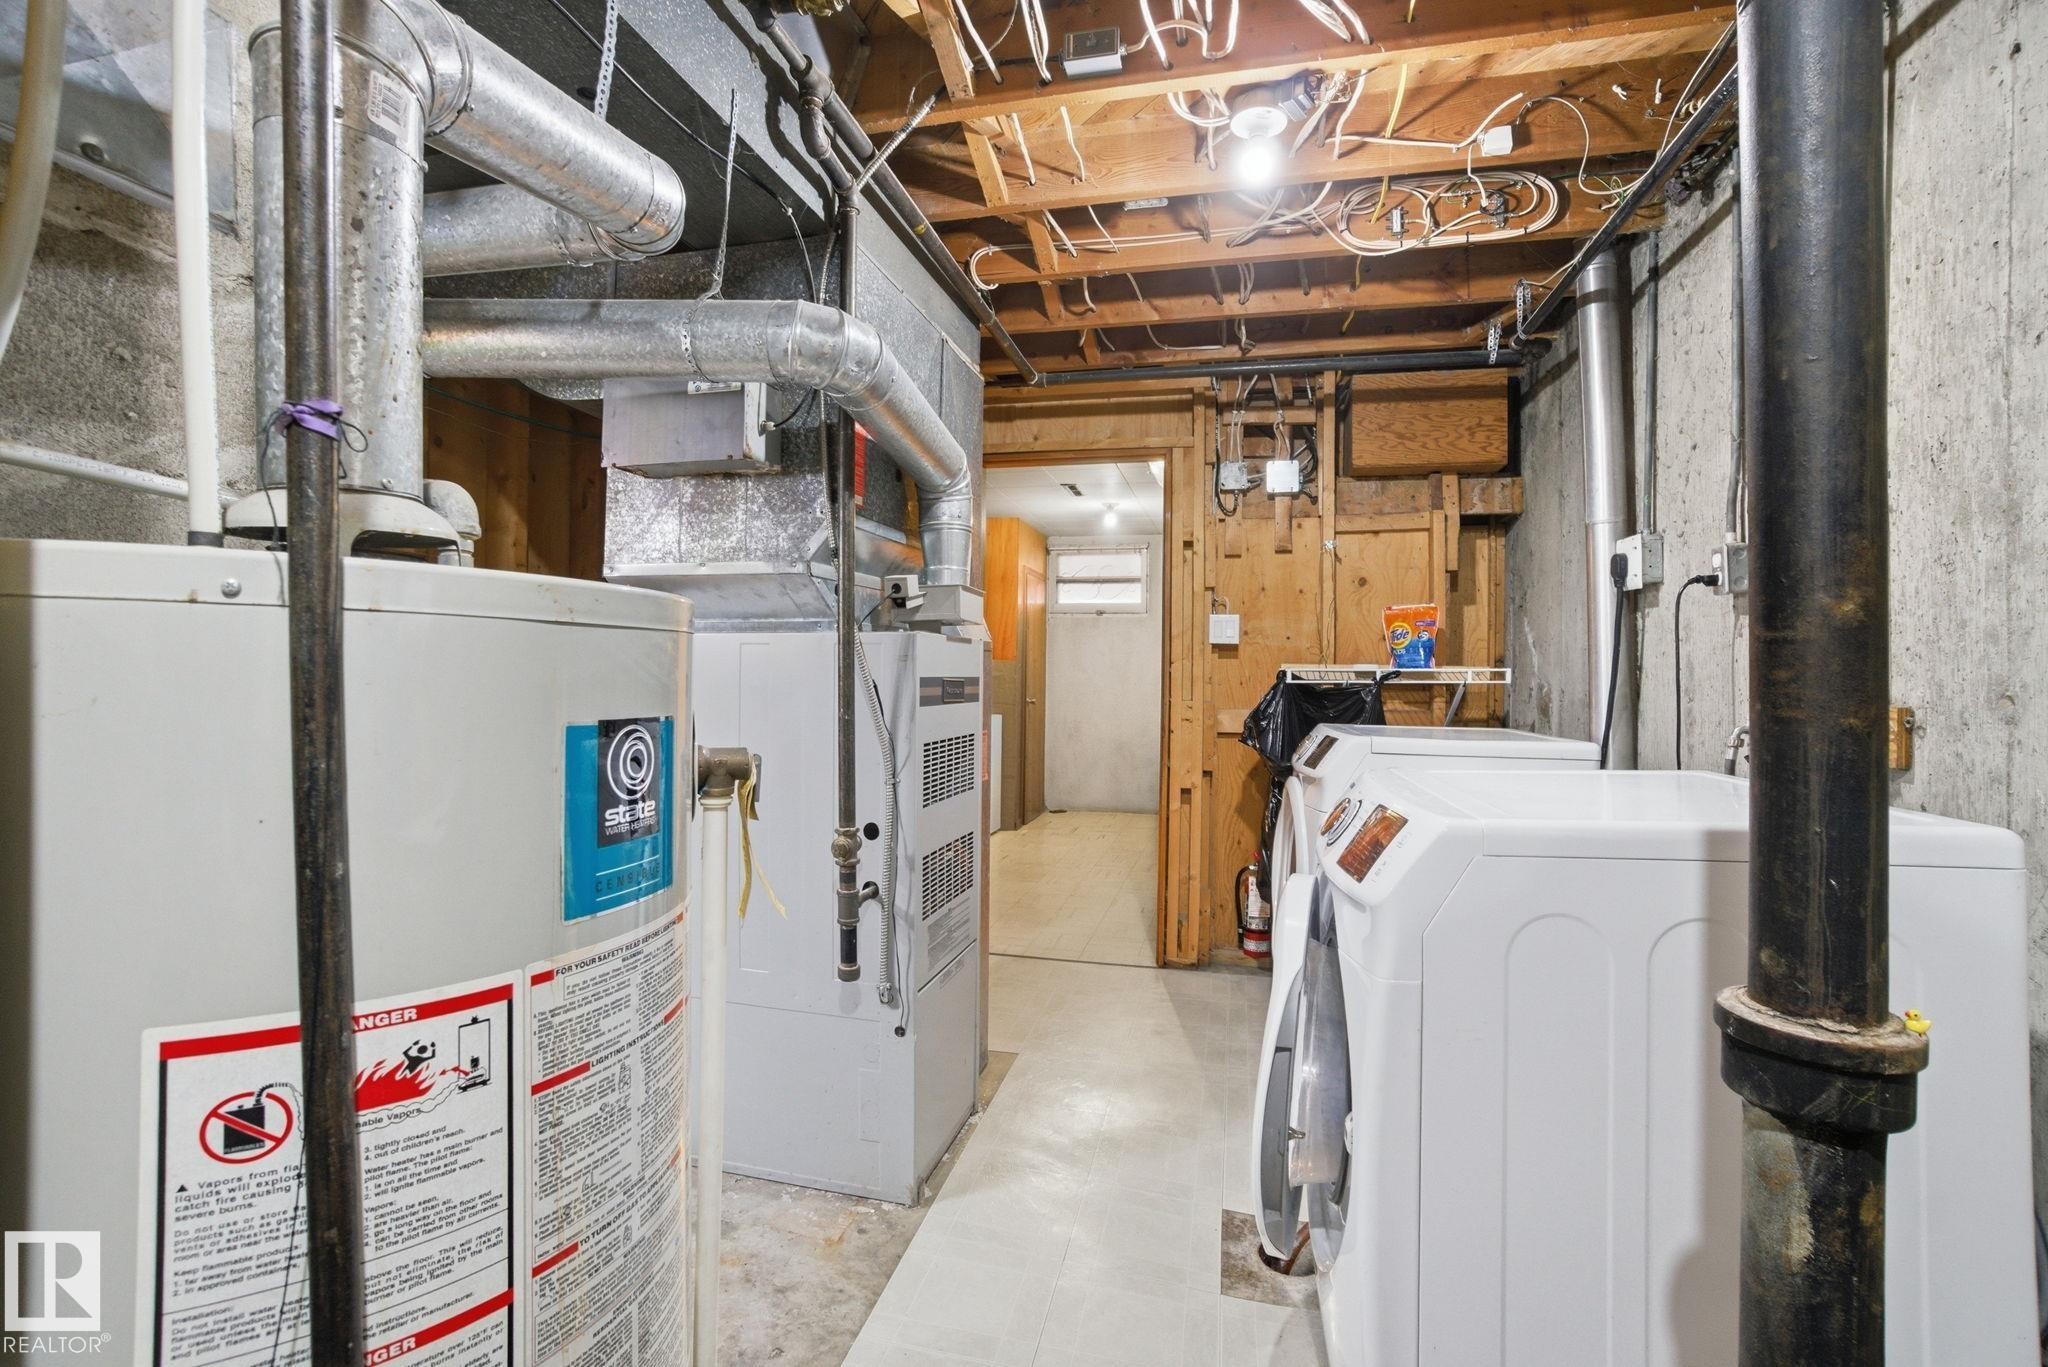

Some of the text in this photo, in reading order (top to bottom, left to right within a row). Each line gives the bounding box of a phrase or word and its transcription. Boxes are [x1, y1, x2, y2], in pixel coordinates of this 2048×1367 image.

[605, 800, 656, 826] state
[605, 824, 630, 835] WATER
[555, 965, 573, 976] FOR
[574, 958, 597, 970] YOUR
[597, 947, 624, 962] SAFETY
[625, 940, 641, 952] READ
[642, 930, 661, 944] BEFORE
[354, 1008, 417, 1030] NGER
[591, 1045, 625, 1067] LIGHTING
[387, 1107, 421, 1121] Vapors
[364, 1124, 447, 1153] 3. tightly closed and
[364, 1127, 466, 1161] 4. out of children's reach.
[364, 1126, 504, 1174] Water heater has main burner and
[364, 1145, 473, 1183] pilot flame. The pilot flame:
[364, 1184, 372, 1192] 1.
[384, 1179, 396, 1187] on
[396, 1173, 408, 1183] all
[410, 1170, 423, 1179] the
[424, 1165, 442, 1175] time
[443, 1158, 458, 1169] and
[174, 1182, 250, 1203] liquids will
[198, 1170, 278, 1189] Vapors from
[364, 1158, 486, 1200] 2. will ignite flammable vapors.
[174, 1186, 292, 1213] catch fire causing
[364, 1200, 398, 1213] Vapors:
[364, 1196, 440, 1222] 1. cannot be seen.
[174, 1210, 216, 1222] severe
[174, 1229, 190, 1237] Do
[194, 1223, 214, 1234] not
[218, 1220, 238, 1229] use
[260, 1210, 288, 1220] store
[374, 1198, 454, 1229] are heavier than air.
[374, 1191, 492, 1239] go long way on the floor and
[374, 1193, 504, 1244] can be carried from other rooms
[374, 1201, 500, 1252] to the pilot flame by air currents.
[174, 1230, 224, 1246] products
[228, 1222, 255, 1235] such
[174, 1242, 204, 1253] vents
[226, 1226, 280, 1243] adhesives
[580, 1235, 590, 1246] TO
[591, 1221, 612, 1239] TURN
[612, 1209, 625, 1223] OFF
[172, 1251, 200, 1261] room
[216, 1244, 238, 1253] area
[240, 1239, 262, 1248] near
[264, 1234, 280, 1243] the
[394, 1237, 474, 1273] the floor. This will
[174, 1253, 254, 1276] Keep flammable
[256, 1259, 281, 1270] water
[385, 1271, 402, 1283] not
[458, 1247, 472, 1258] the
[398, 1273, 423, 1286] being
[426, 1259, 455, 1278] ignited
[470, 1249, 483, 1259] the
[484, 1240, 504, 1252] main
[184, 1274, 244, 1294] in approved
[408, 1277, 428, 1292] pilot
[429, 1269, 455, 1282] flame.
[172, 1305, 277, 1335] Do not water
[230, 1313, 276, 1332] products
